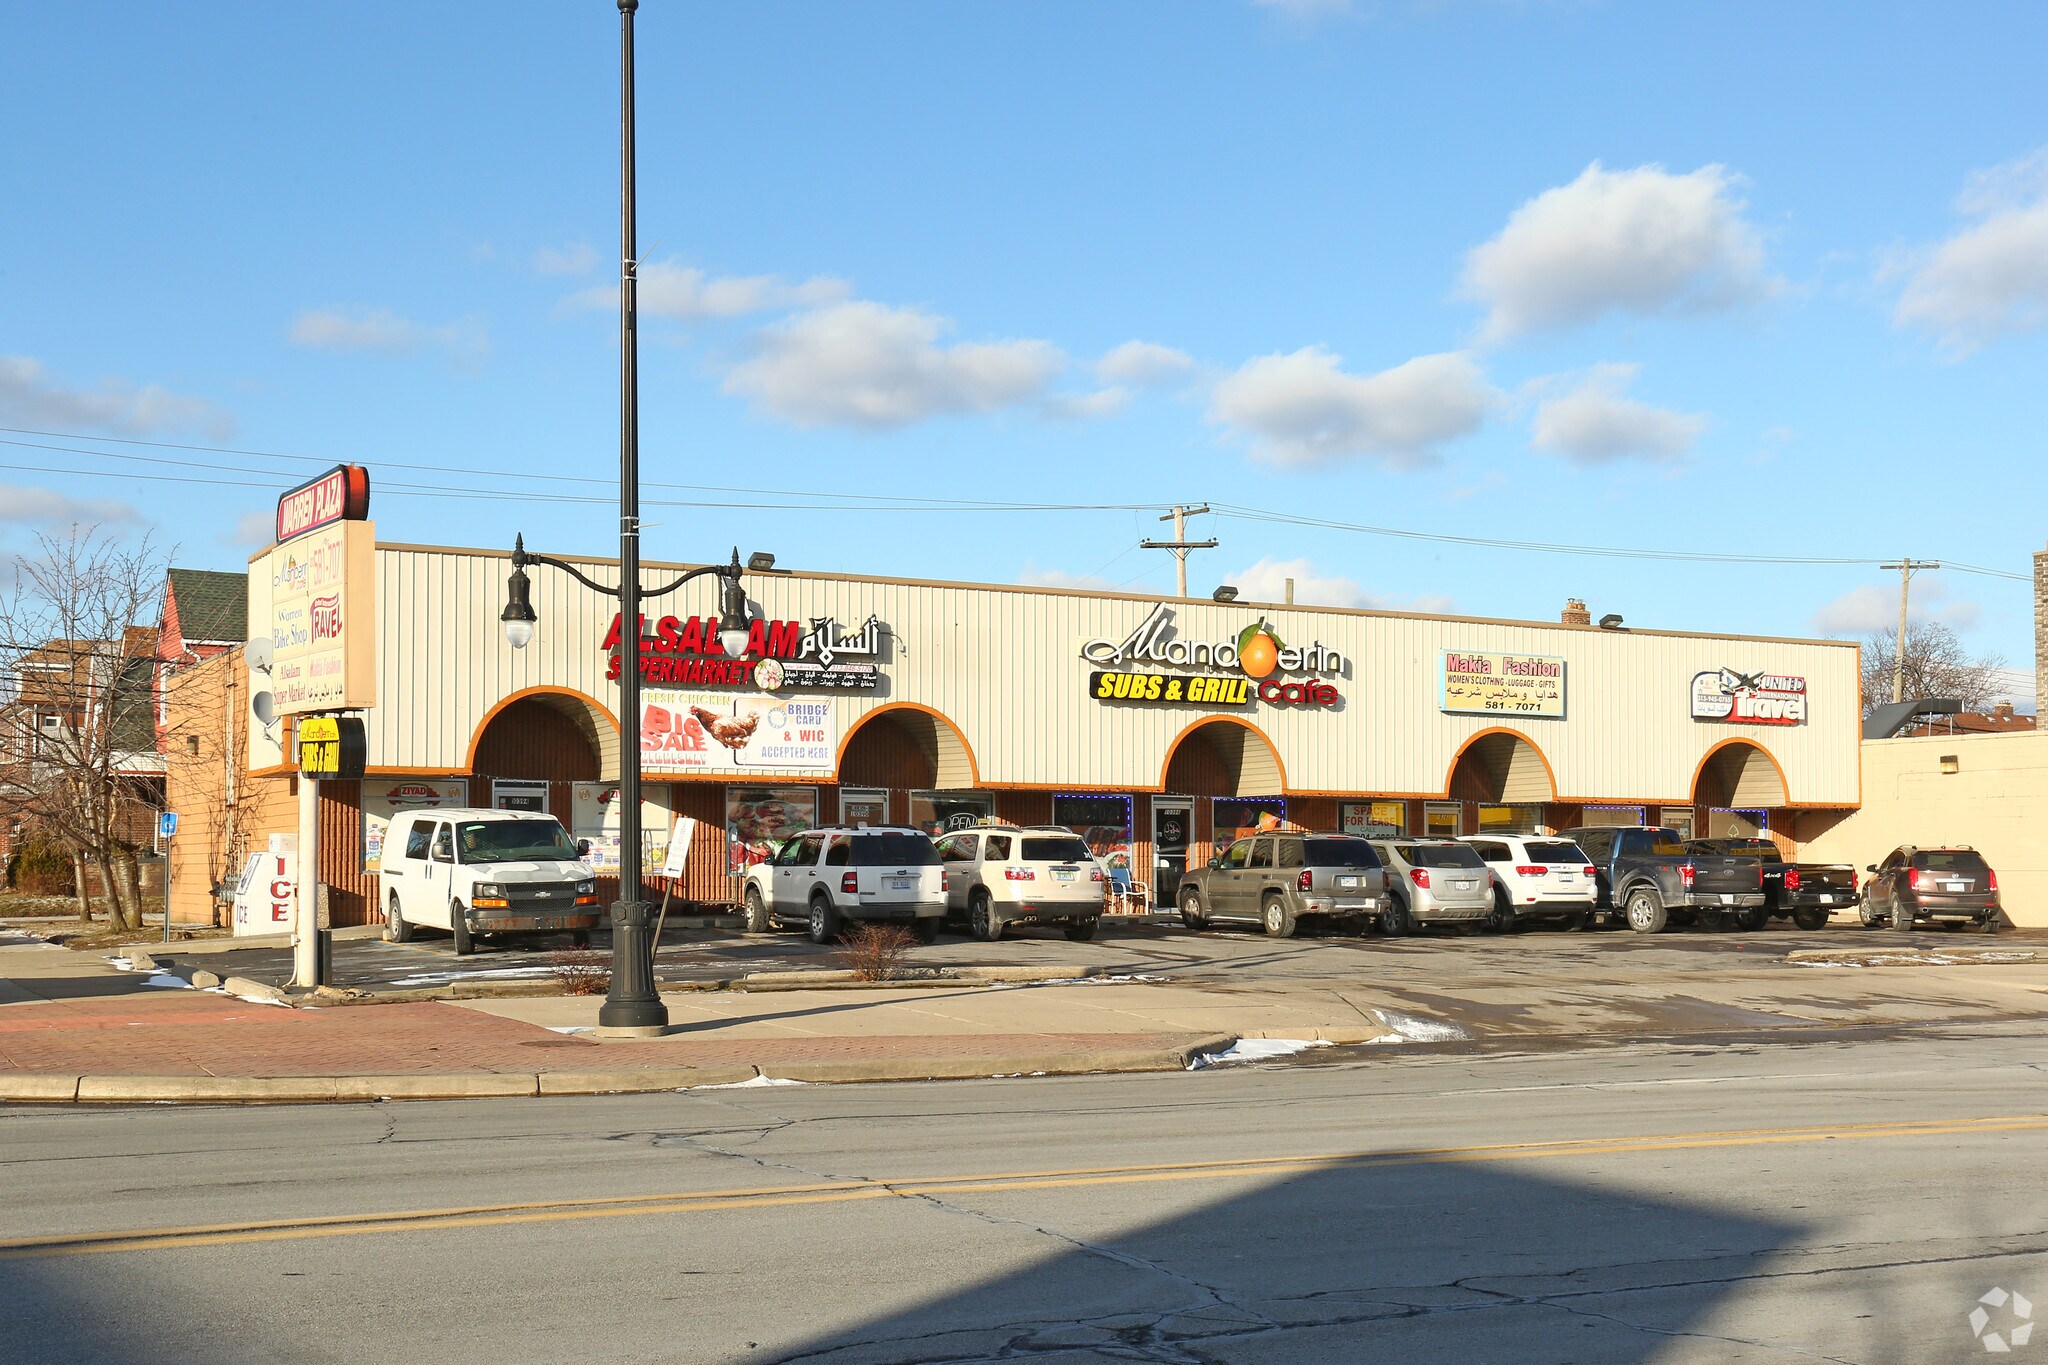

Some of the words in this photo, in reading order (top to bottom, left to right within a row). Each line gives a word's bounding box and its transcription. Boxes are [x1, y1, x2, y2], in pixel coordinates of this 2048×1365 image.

[282, 489, 314, 535] WARREN
[315, 475, 341, 522] PLAZA
[278, 608, 302, 622] Warren
[310, 602, 343, 645] TRAVEL
[274, 628, 289, 649] Bike
[291, 623, 308, 647] Shop
[280, 663, 300, 680] Alsalam
[607, 654, 758, 685] SPERMARKET
[1446, 653, 1491, 675] Makia
[1502, 657, 1560, 677] Fashion
[1097, 673, 1163, 700] SUBS
[1165, 680, 1182, 700] &
[1187, 677, 1248, 704] GRILL
[1447, 675, 1475, 684] WOMEN'S
[1475, 676, 1504, 686] CLOTHING
[1538, 680, 1556, 689] GIFTS
[1765, 677, 1803, 690] UNITED
[274, 686, 287, 709] Super
[288, 681, 306, 702] Market
[642, 692, 675, 704] FRESH
[679, 693, 733, 706] CHICKEN
[1486, 688, 1518, 700] ملابس
[1535, 690, 1558, 701] هدايا
[1757, 692, 1800, 700] INTERNATIONAL
[788, 704, 827, 716] BRIDGE
[1485, 701, 1504, 710] 581
[1515, 702, 1541, 711] 7071
[642, 704, 703, 737] BIG
[796, 715, 821, 725] CARD
[640, 729, 708, 752] SALE
[784, 731, 791, 741] &
[799, 730, 824, 742] WIC
[302, 742, 319, 772] SUBS
[318, 747, 323, 772] &
[323, 742, 339, 772] GRILL
[761, 746, 805, 758] ACCEPTED
[807, 747, 828, 759] HERE
[401, 786, 426, 795] ZIYAD
[1353, 806, 1387, 816] SPACE
[945, 816, 976, 830] OPEN
[1345, 816, 1363, 825] FOR
[1366, 817, 1395, 826] LEASE
[270, 854, 292, 922] ICE
[236, 904, 248, 924] ICE
